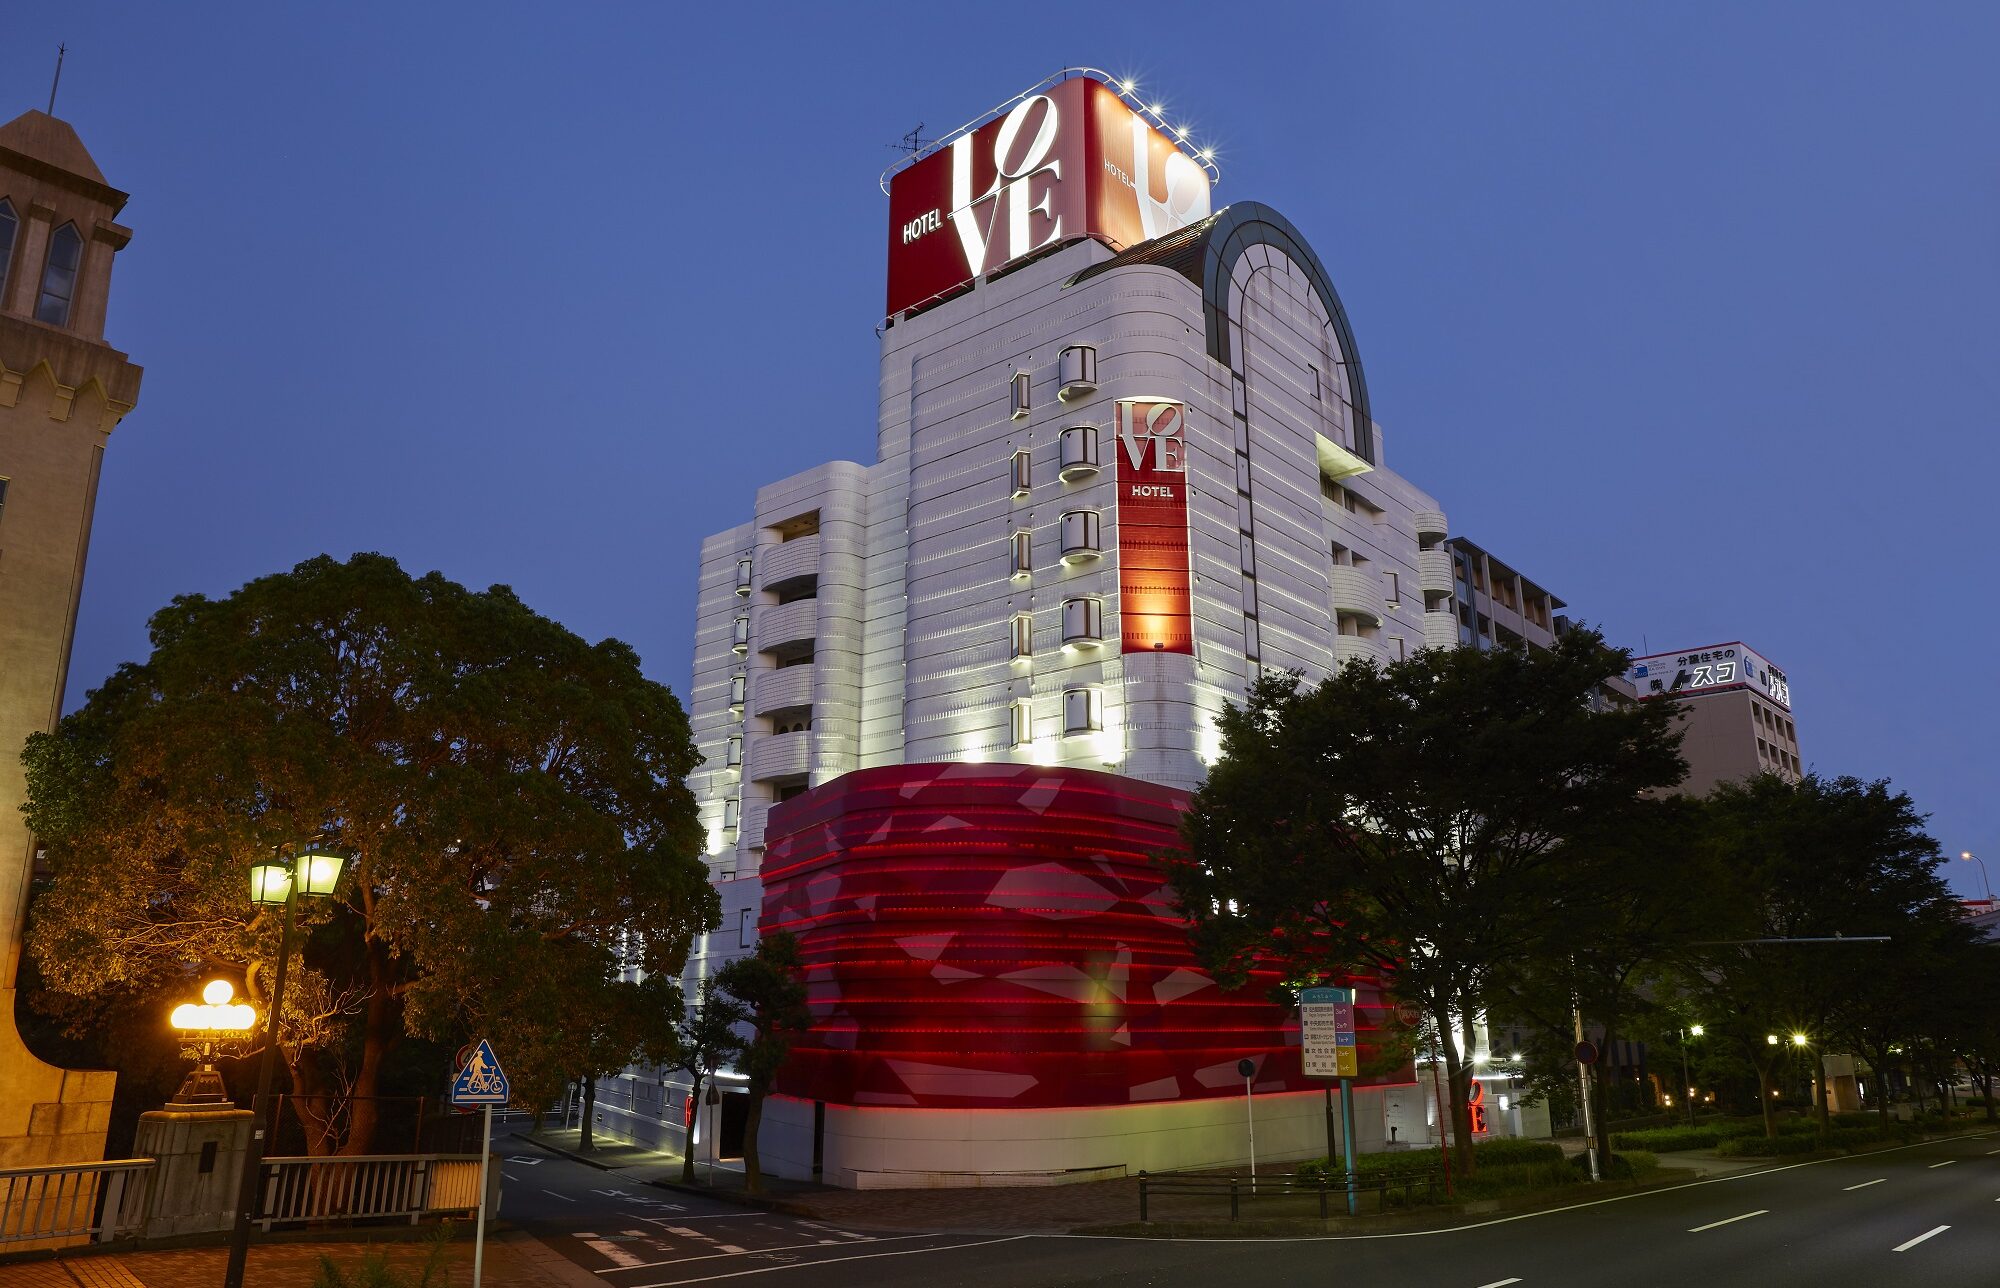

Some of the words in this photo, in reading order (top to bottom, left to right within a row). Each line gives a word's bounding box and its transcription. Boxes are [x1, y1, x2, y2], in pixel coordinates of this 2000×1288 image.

[1104, 158, 1131, 188] HOTEL
[903, 208, 943, 245] HOTEL
[1132, 485, 1173, 497] HOTEL
